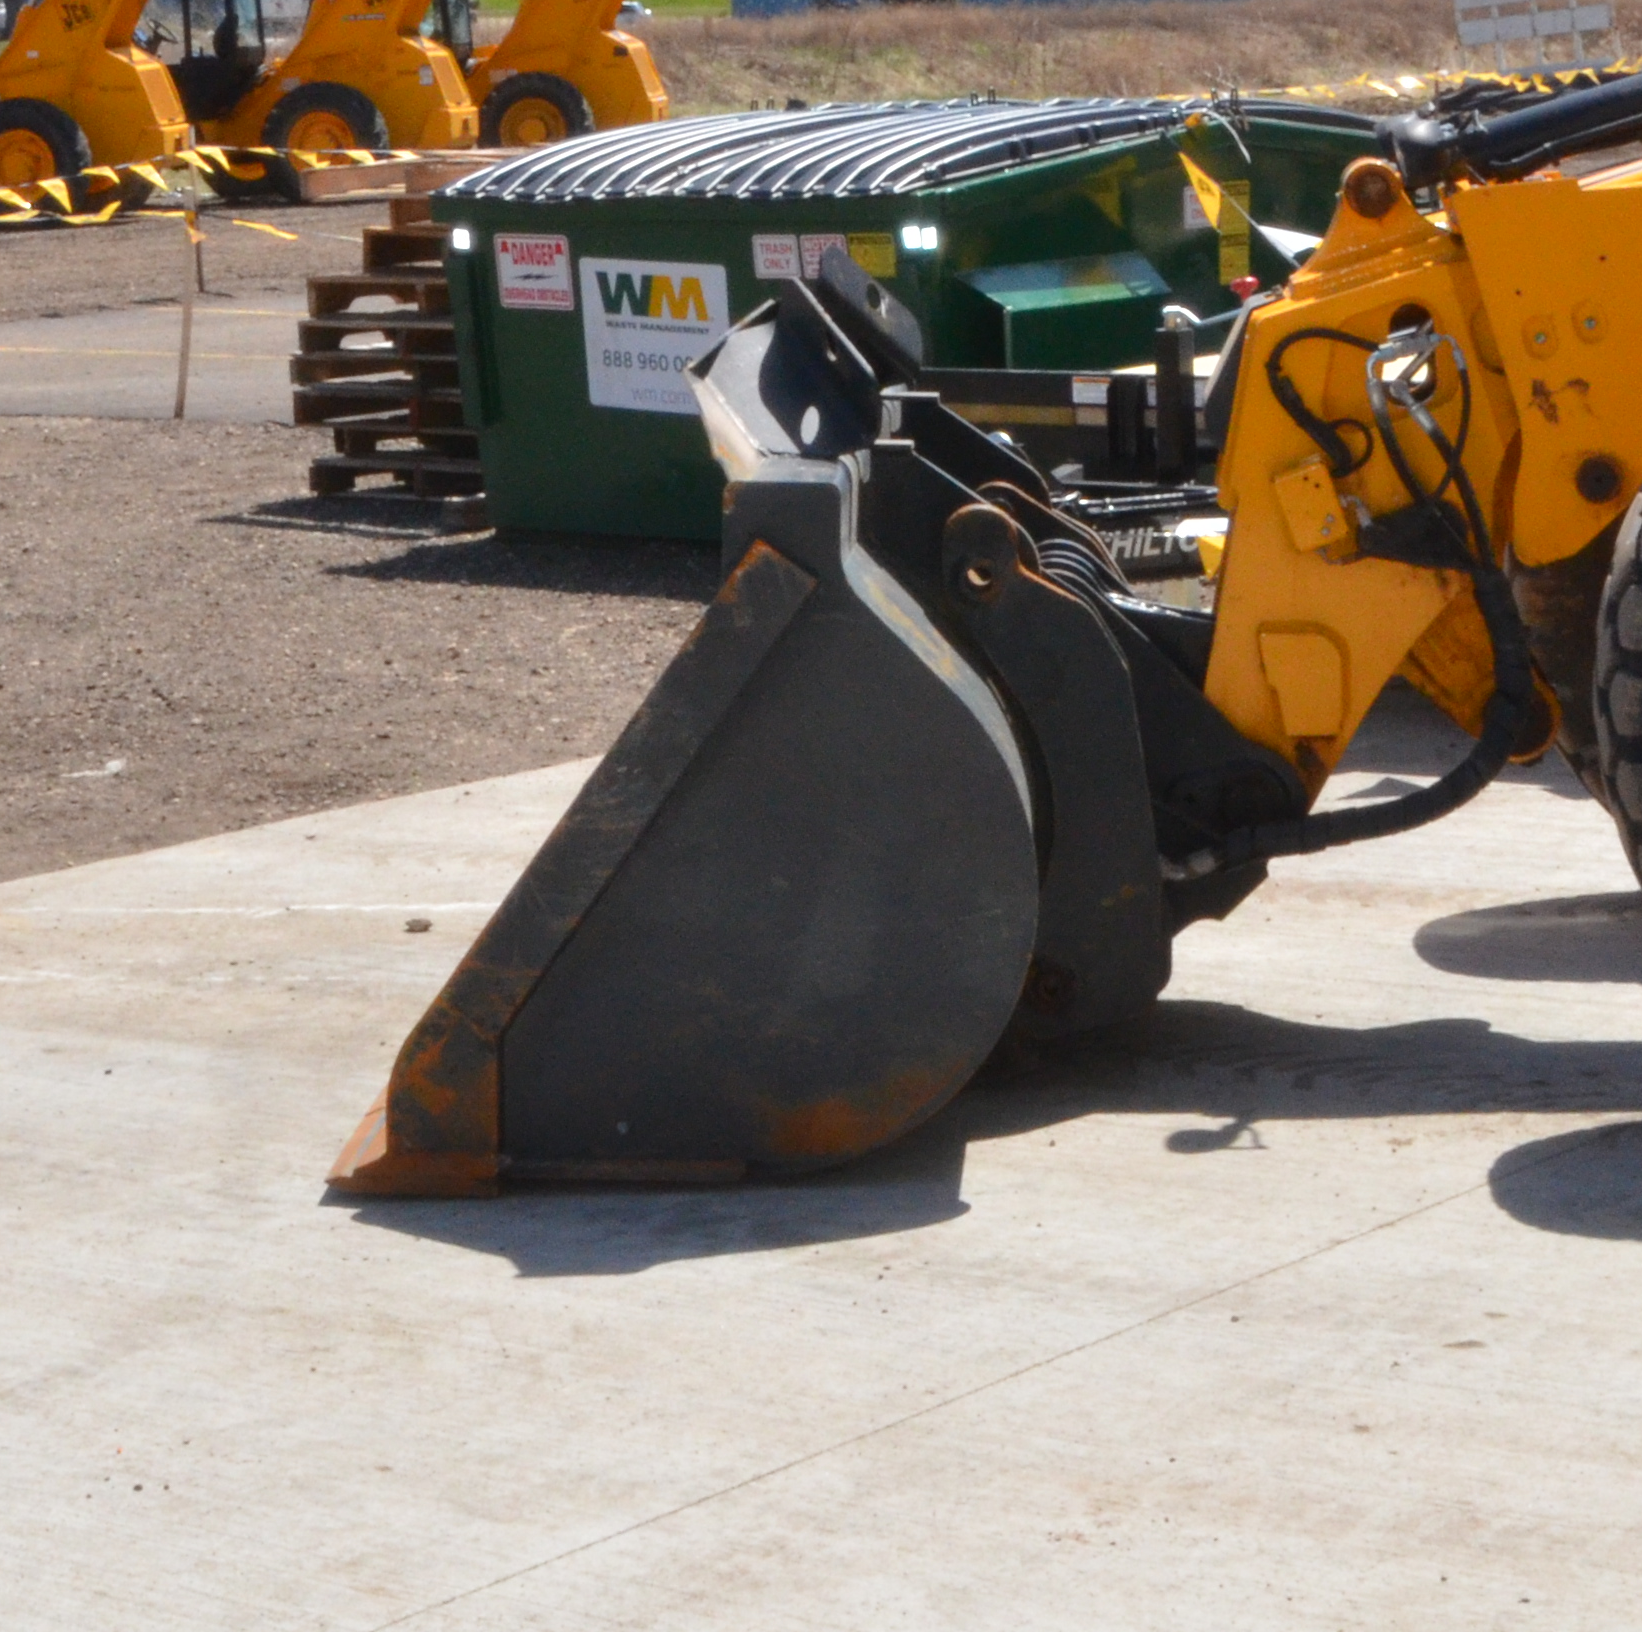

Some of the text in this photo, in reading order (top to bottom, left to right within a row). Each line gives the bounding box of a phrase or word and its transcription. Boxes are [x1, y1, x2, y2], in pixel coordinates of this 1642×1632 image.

[511, 241, 556, 266] DANGER
[760, 243, 793, 255] TRASH
[763, 258, 790, 269] ONLY
[595, 271, 709, 322] WM
[606, 320, 710, 335] WASTE MANAGEMENT
[603, 349, 633, 368] 888
[637, 352, 669, 371] 960
[630, 388, 693, 406] wm.com
